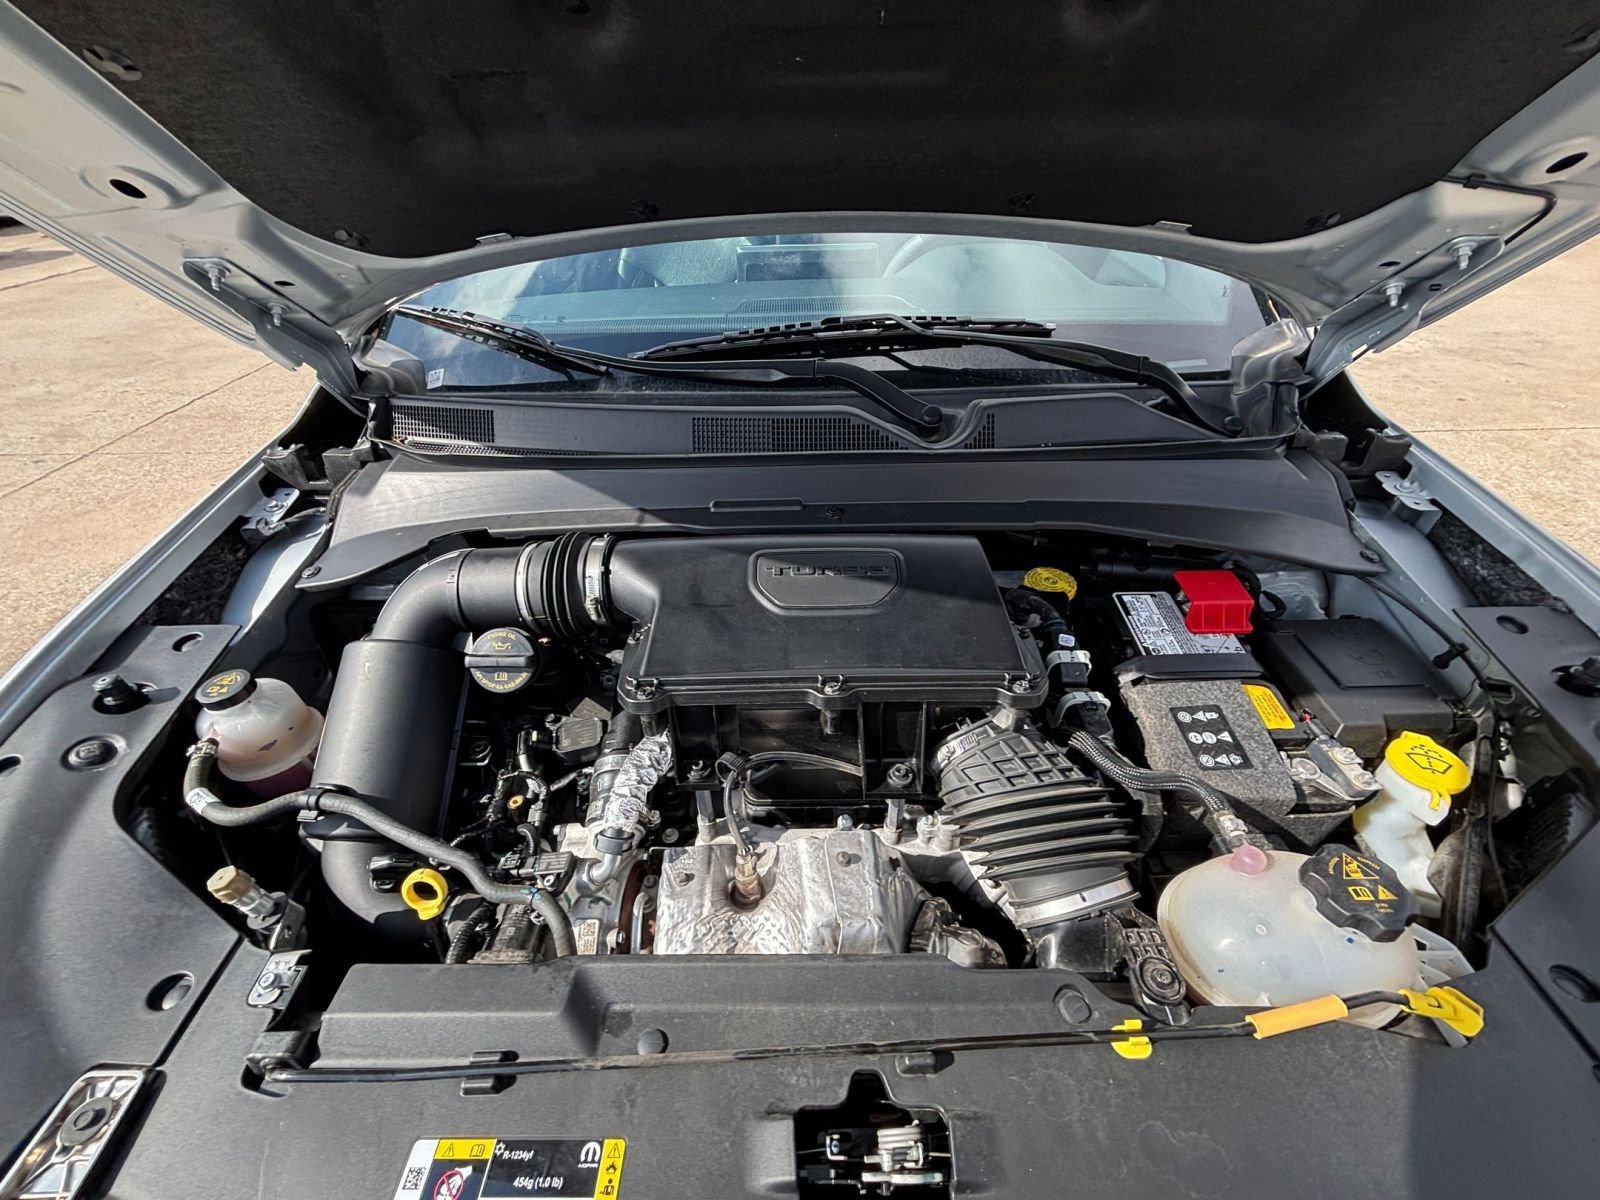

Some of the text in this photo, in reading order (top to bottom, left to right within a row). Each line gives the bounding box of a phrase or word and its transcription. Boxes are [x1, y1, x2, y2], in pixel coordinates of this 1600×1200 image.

[765, 565, 893, 577] TURBO
[502, 1150, 534, 1162] R-1234yf
[513, 1176, 564, 1189] 454g (1.0 lb)
